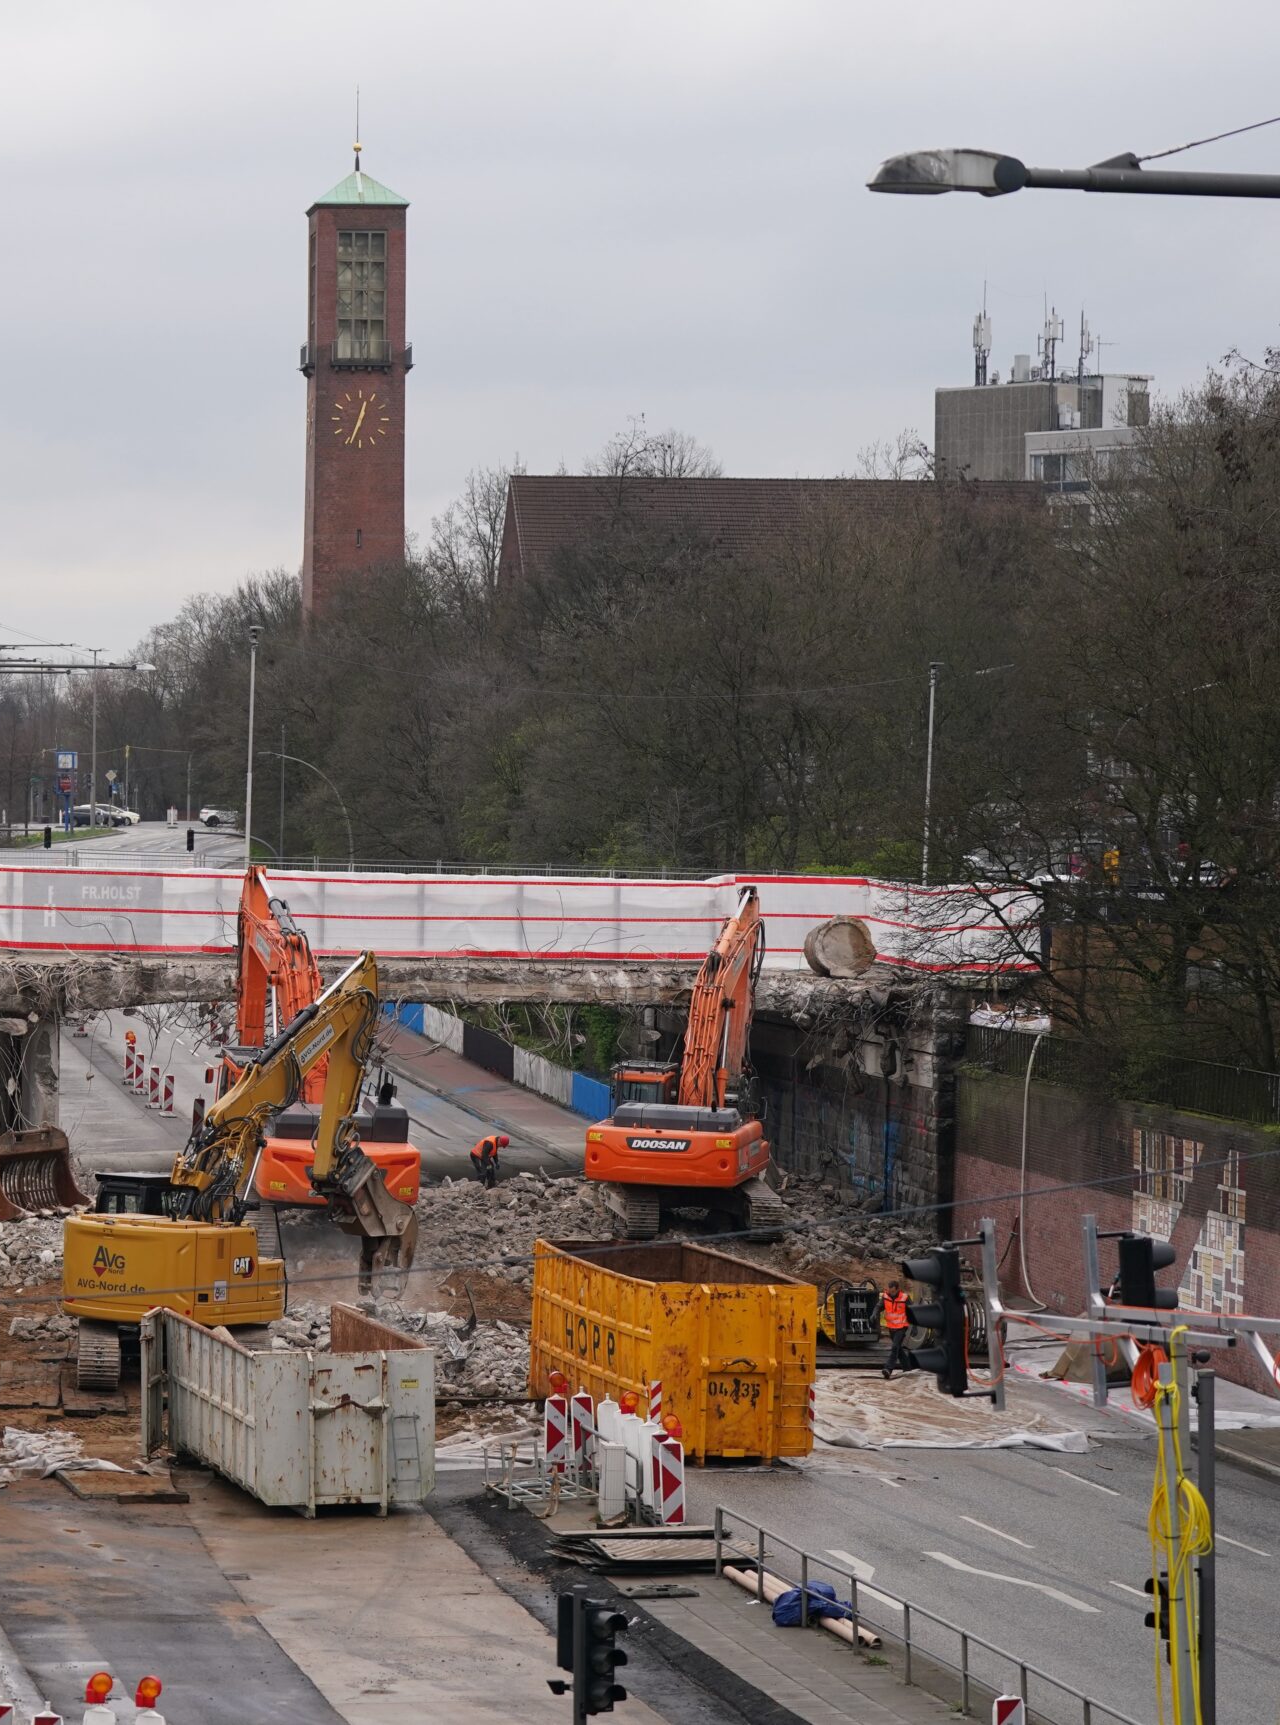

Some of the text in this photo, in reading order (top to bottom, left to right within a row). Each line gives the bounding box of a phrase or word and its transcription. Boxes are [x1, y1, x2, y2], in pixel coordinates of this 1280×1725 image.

[82, 886, 142, 900] FR.HOLST
[631, 1139, 687, 1151] DOOSAN
[93, 1246, 126, 1269] AVG
[233, 1257, 251, 1274] CAT
[77, 1278, 146, 1293] AVG-Nord.de
